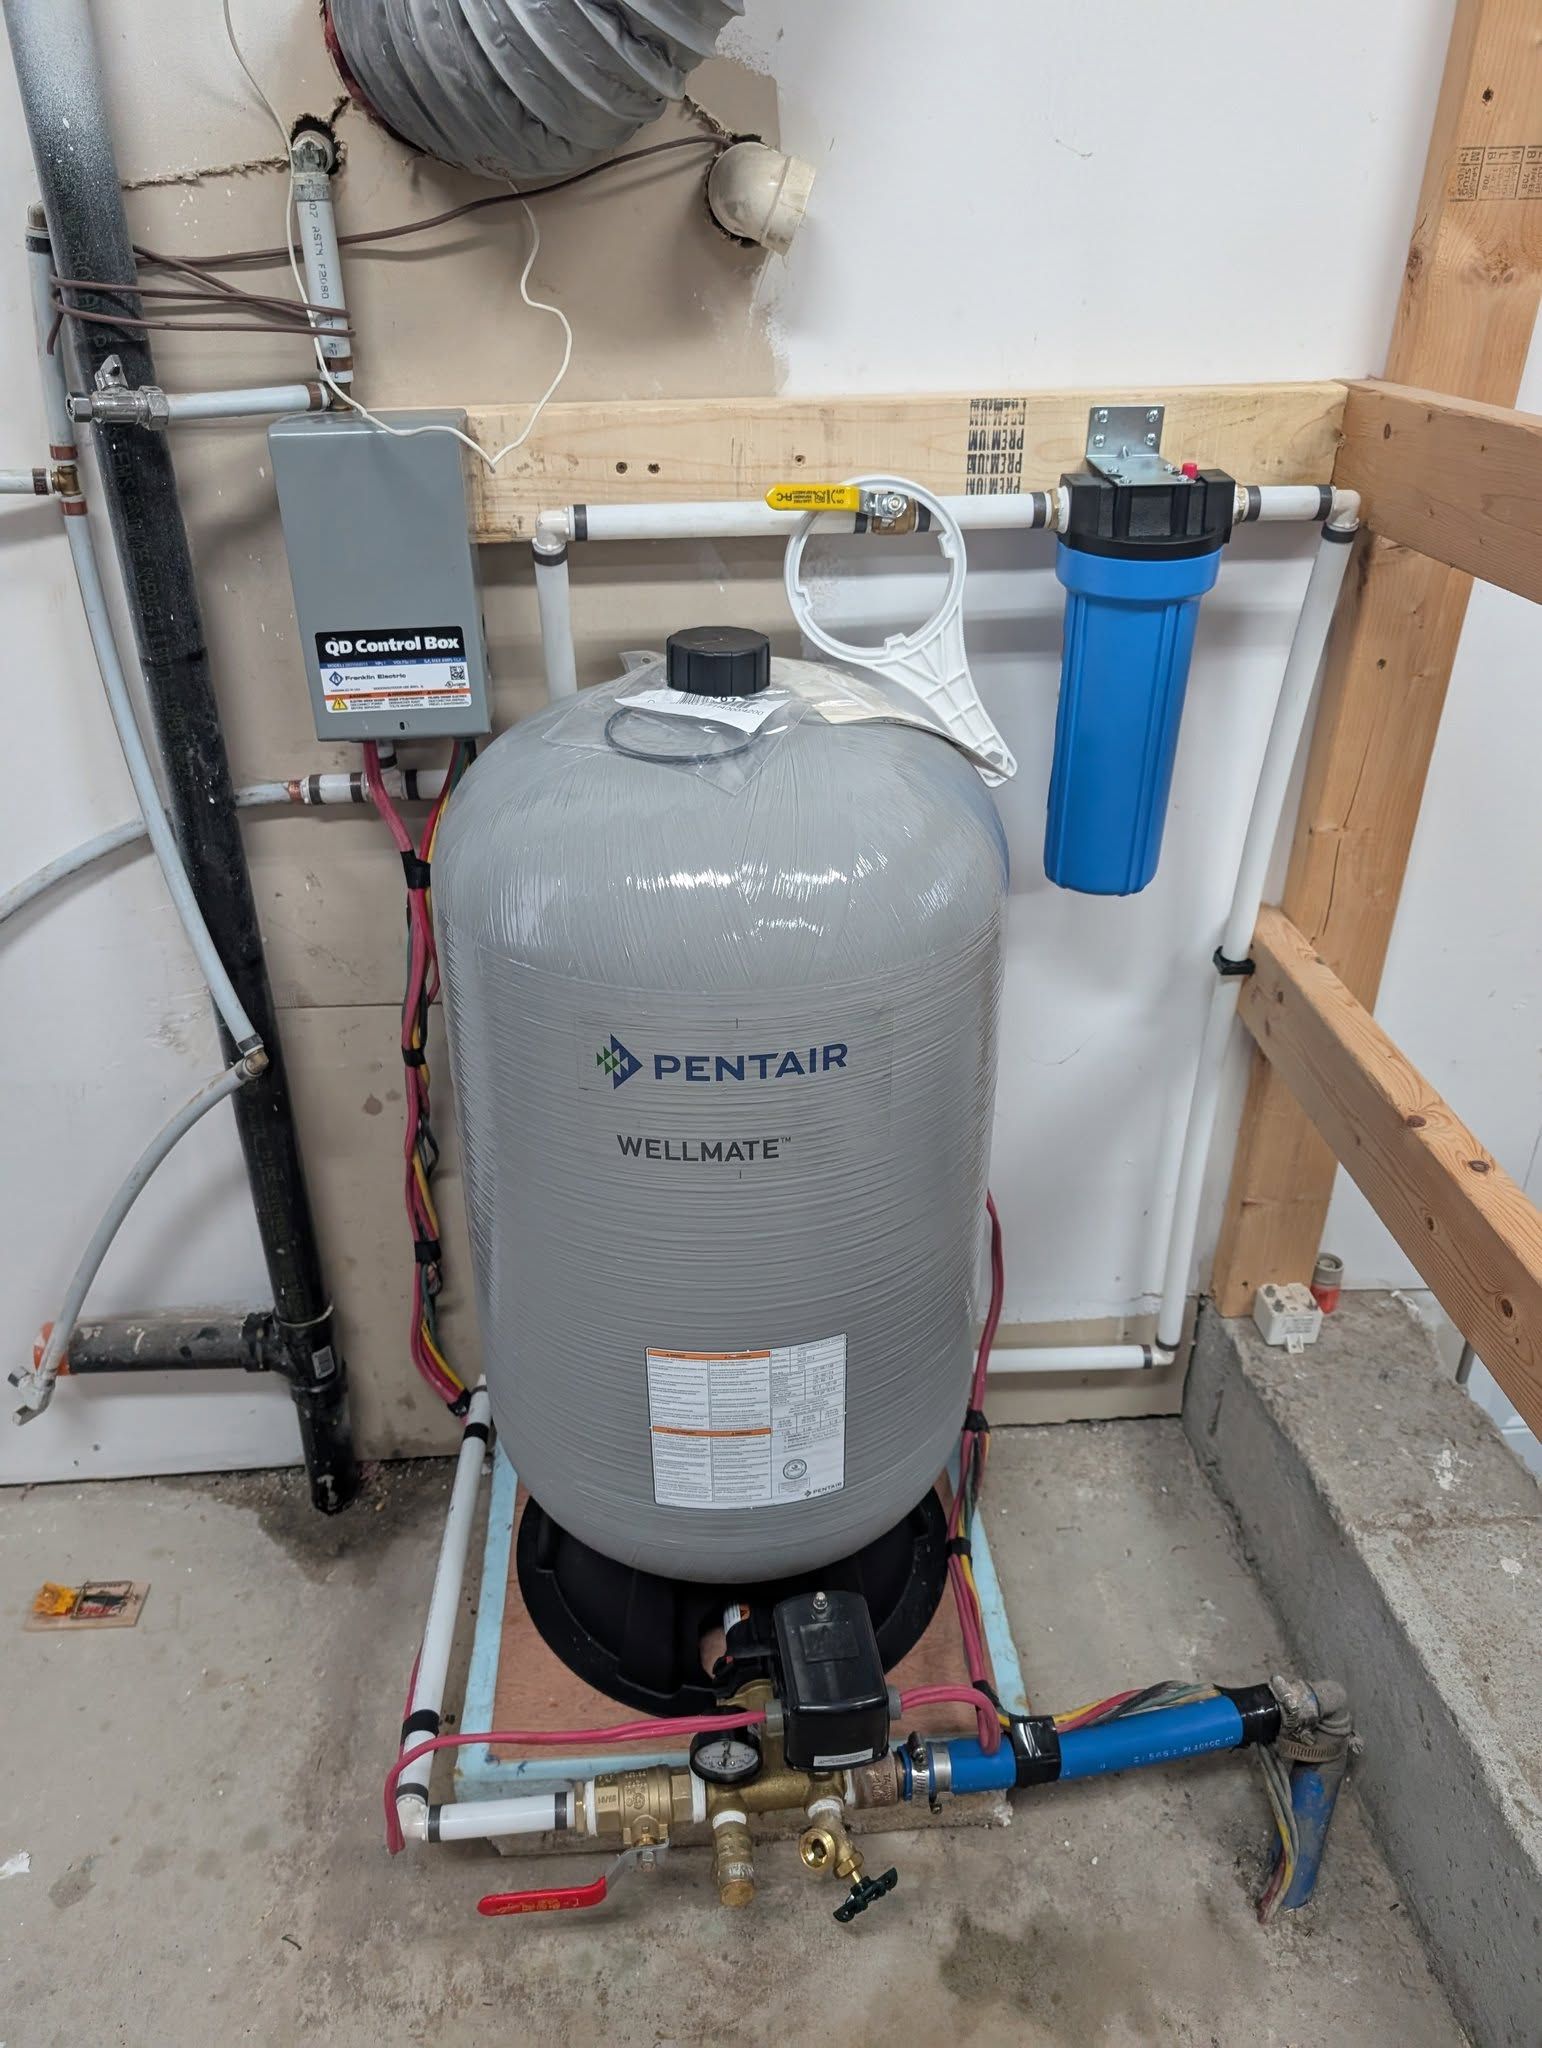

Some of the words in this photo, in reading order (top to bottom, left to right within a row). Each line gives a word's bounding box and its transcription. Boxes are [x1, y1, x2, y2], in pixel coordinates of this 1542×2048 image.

[968, 428, 1025, 451] PREMIUM
[966, 452, 1023, 475] PREMIUM
[324, 640, 353, 657] QD
[355, 636, 421, 653] Control
[424, 636, 460, 650] Box
[653, 1043, 849, 1082] PENTAIR
[813, 1482, 842, 1494] PENTAIR
